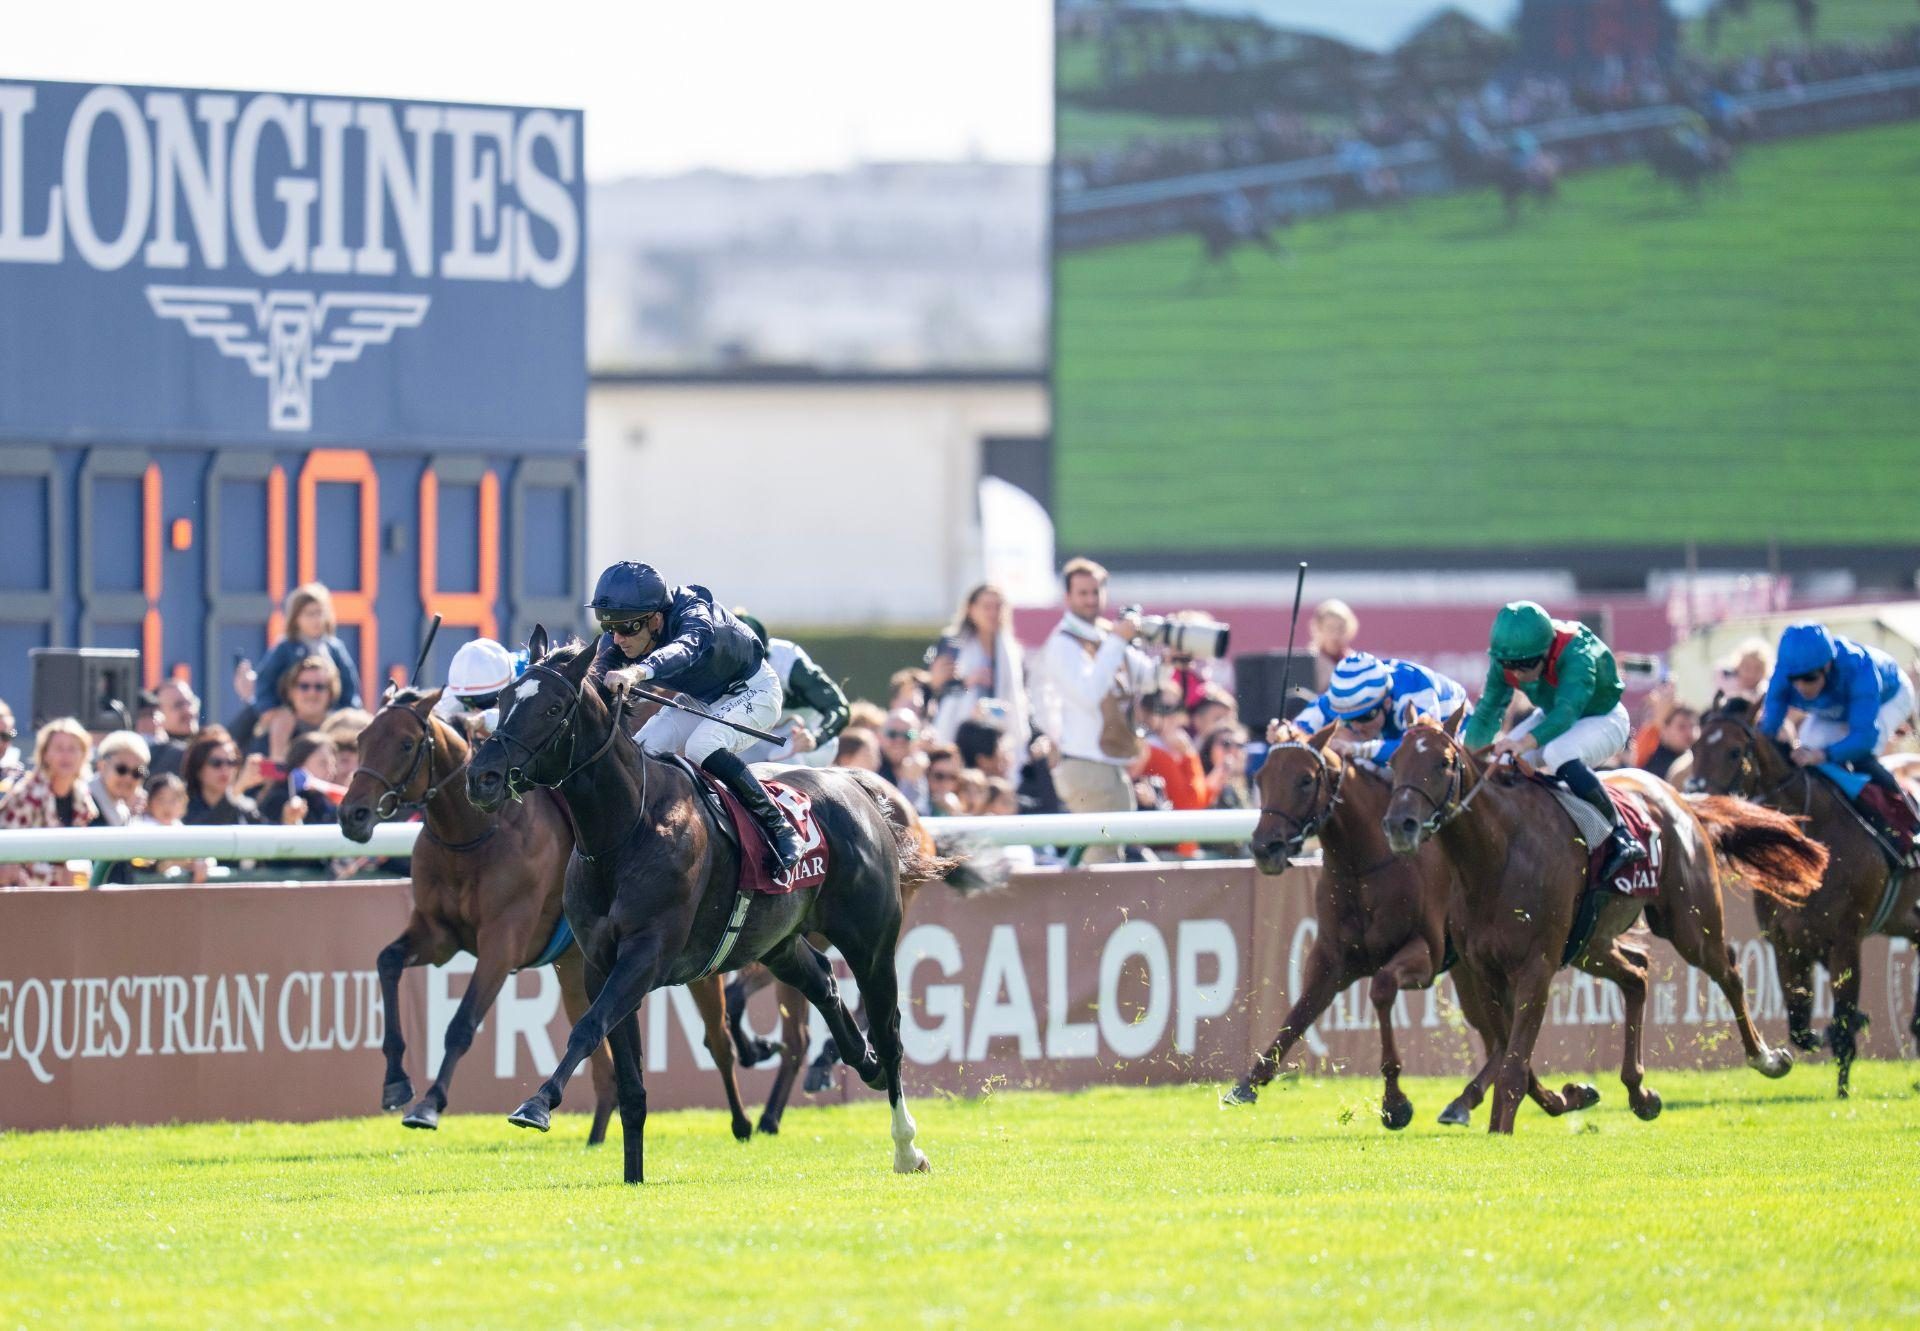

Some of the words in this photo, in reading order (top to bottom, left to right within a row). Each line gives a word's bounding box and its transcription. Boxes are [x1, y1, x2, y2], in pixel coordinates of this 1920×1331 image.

[0, 85, 580, 289] LONGINES
[773, 856, 825, 889] QTAR
[278, 971, 386, 1053] CLUB
[426, 945, 873, 1081] FRN
[896, 917, 1239, 1066] GALOP
